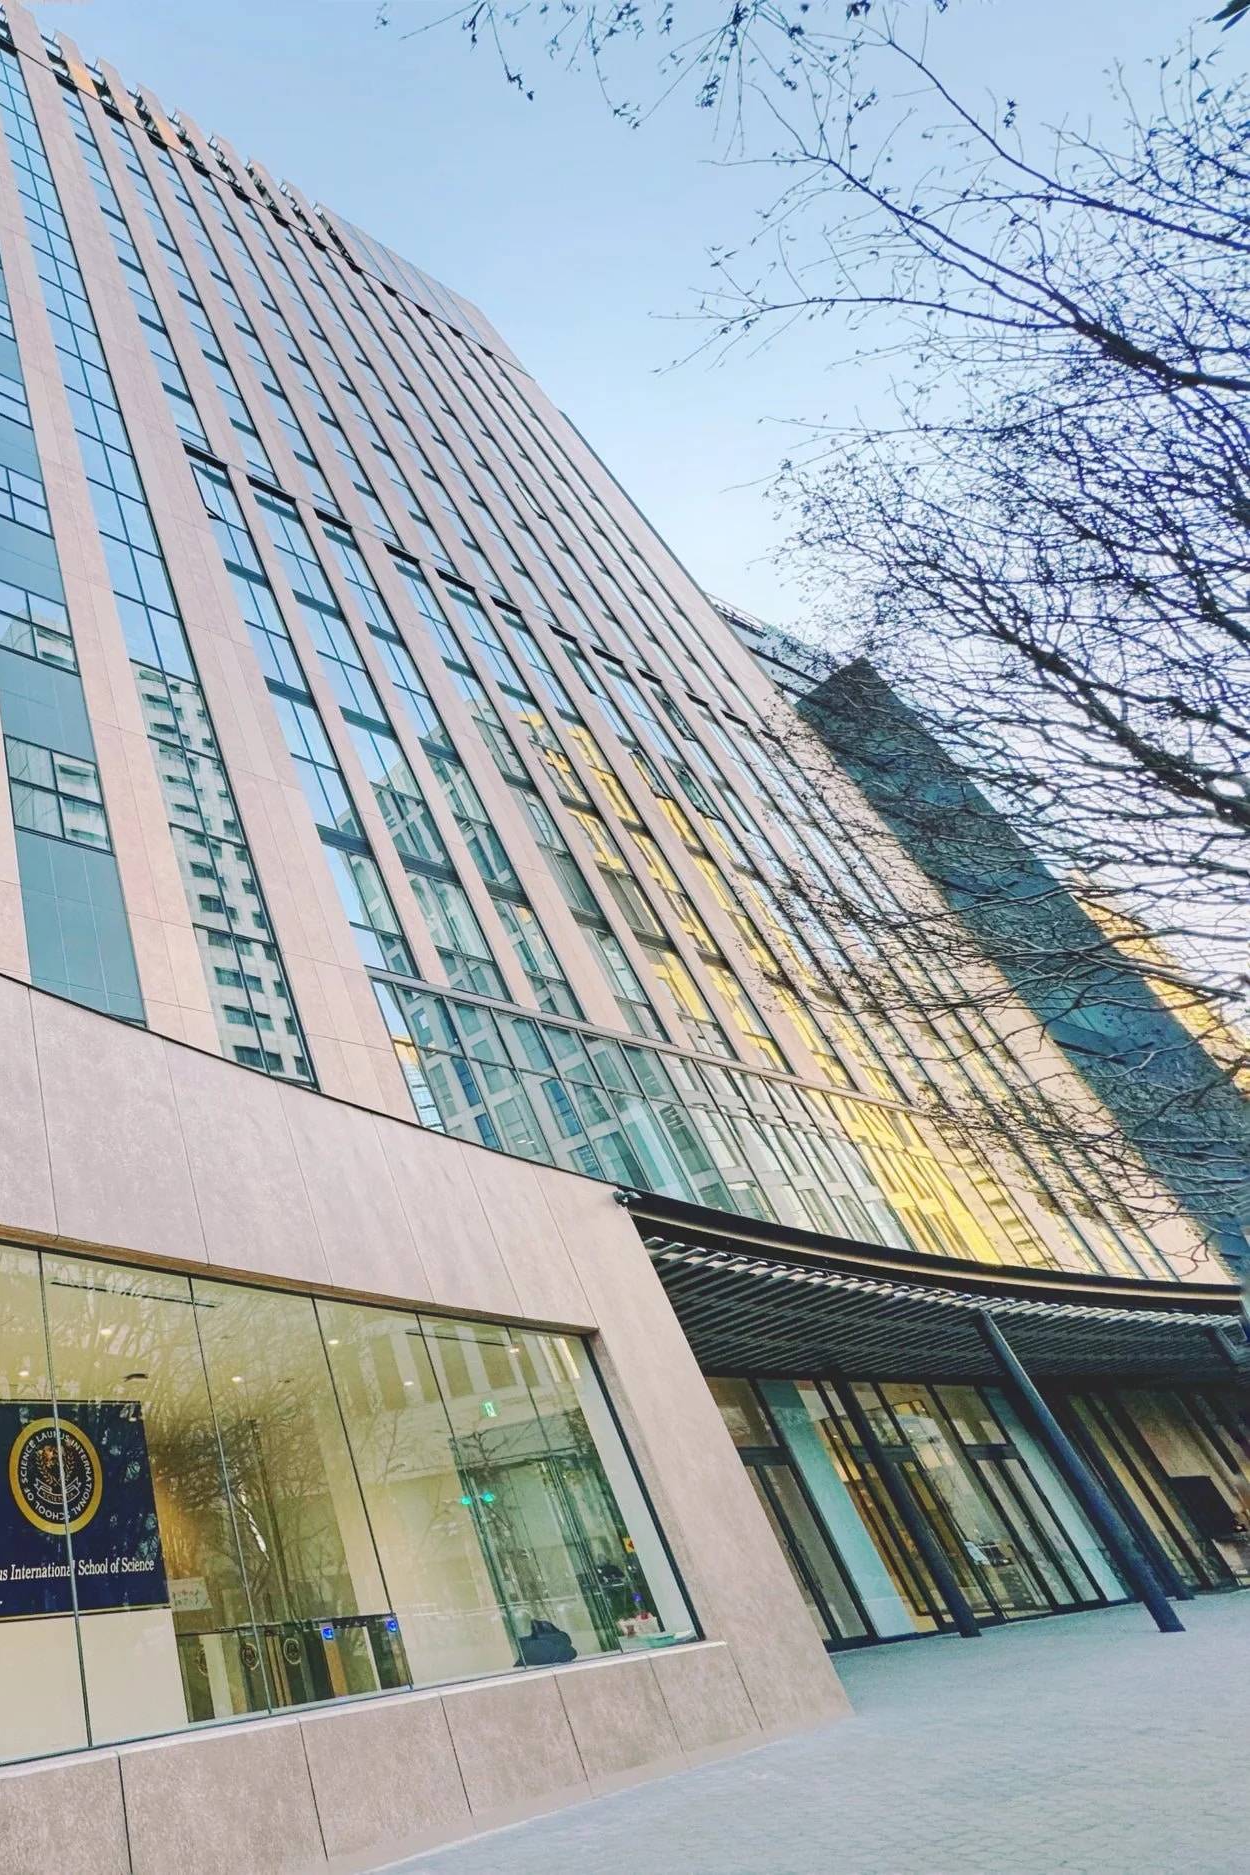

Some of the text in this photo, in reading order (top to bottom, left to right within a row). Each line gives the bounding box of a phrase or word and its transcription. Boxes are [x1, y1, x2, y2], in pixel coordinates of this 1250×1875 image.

[20, 1440, 36, 1484] SCIENCE
[70, 1439, 93, 1515] INTERNATIONAL
[24, 1487, 35, 1501] OF
[78, 1559, 108, 1576] School
[110, 1557, 120, 1574] of
[121, 1557, 155, 1573] Science
